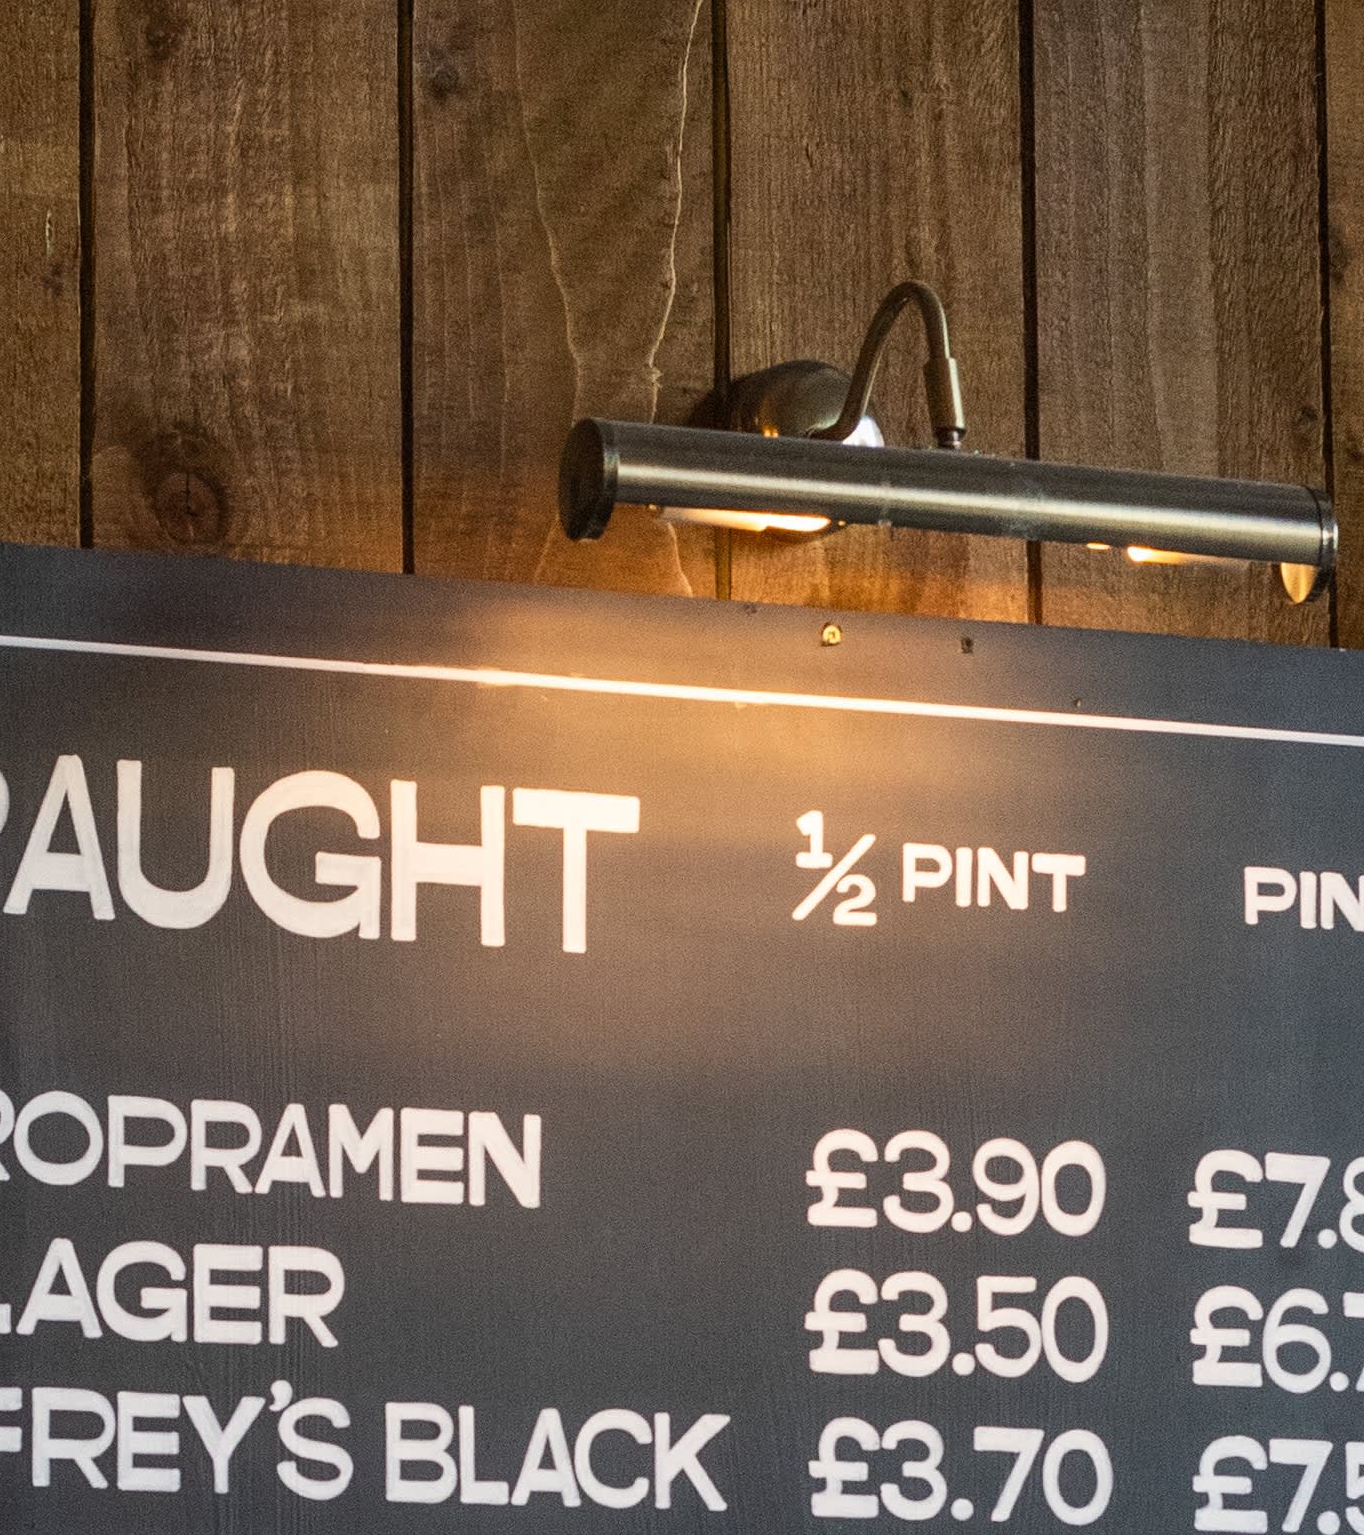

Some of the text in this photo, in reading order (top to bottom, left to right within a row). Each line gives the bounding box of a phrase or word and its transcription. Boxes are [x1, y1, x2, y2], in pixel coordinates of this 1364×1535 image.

[901, 841, 1087, 913] PINT
[805, 1128, 1107, 1237] £3.90
[804, 1268, 1109, 1384] £3.50
[384, 1401, 731, 1512] BLACK
[807, 1416, 1114, 1526] £3.70
